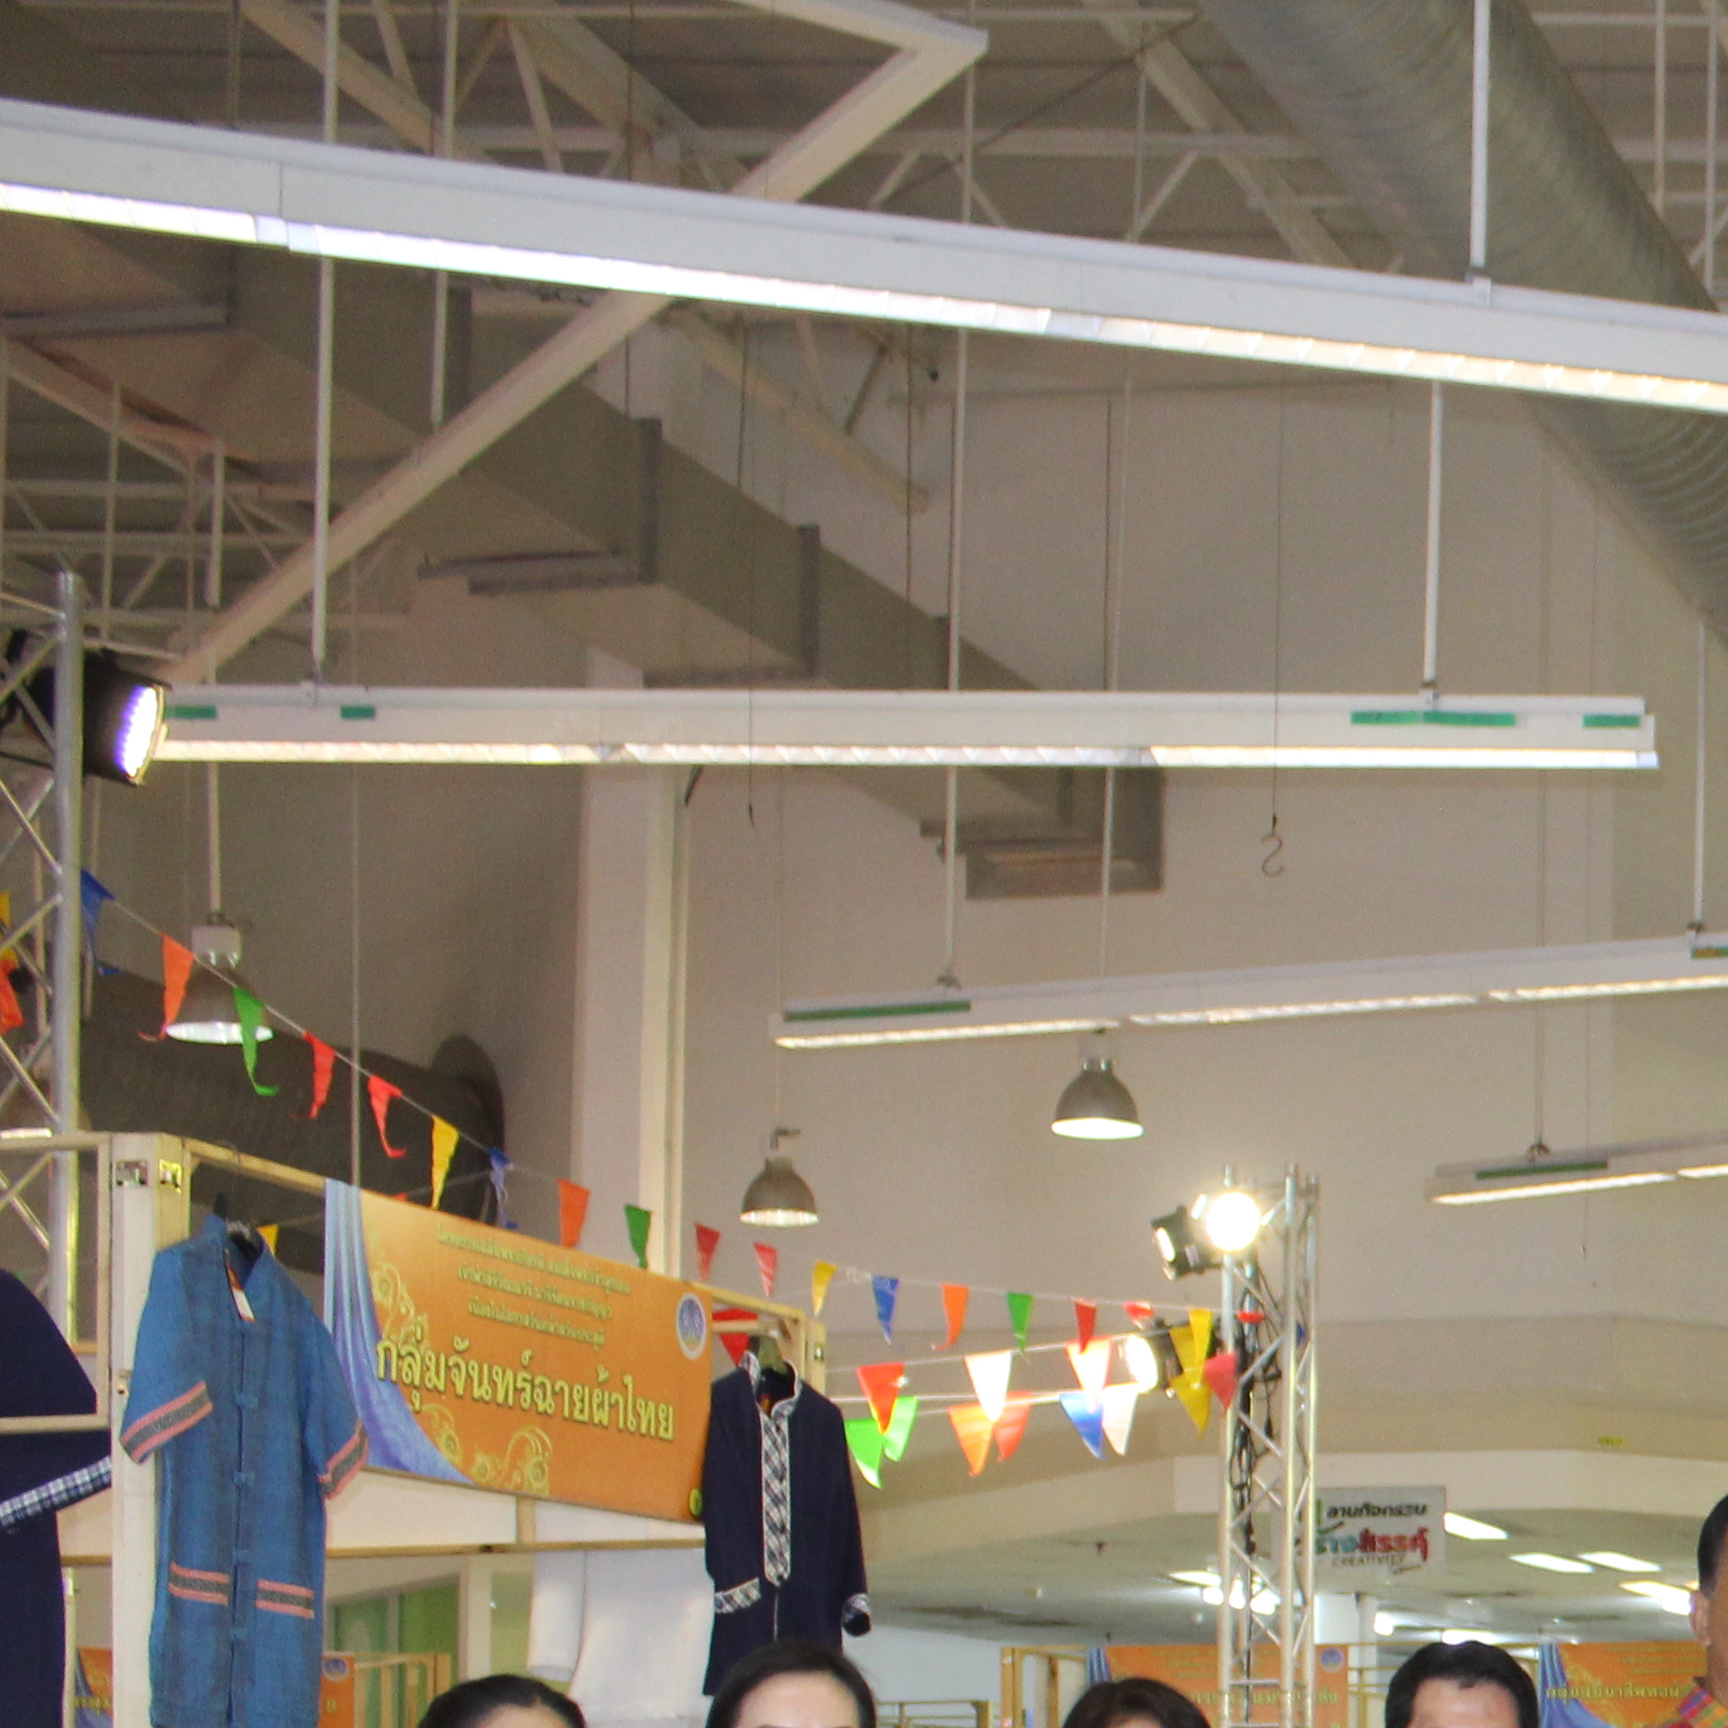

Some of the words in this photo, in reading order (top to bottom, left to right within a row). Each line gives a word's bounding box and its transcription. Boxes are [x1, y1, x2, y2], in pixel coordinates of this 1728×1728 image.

[376, 1324, 675, 1441] กลุ่มจันทร์ฉายผ้าไทย
